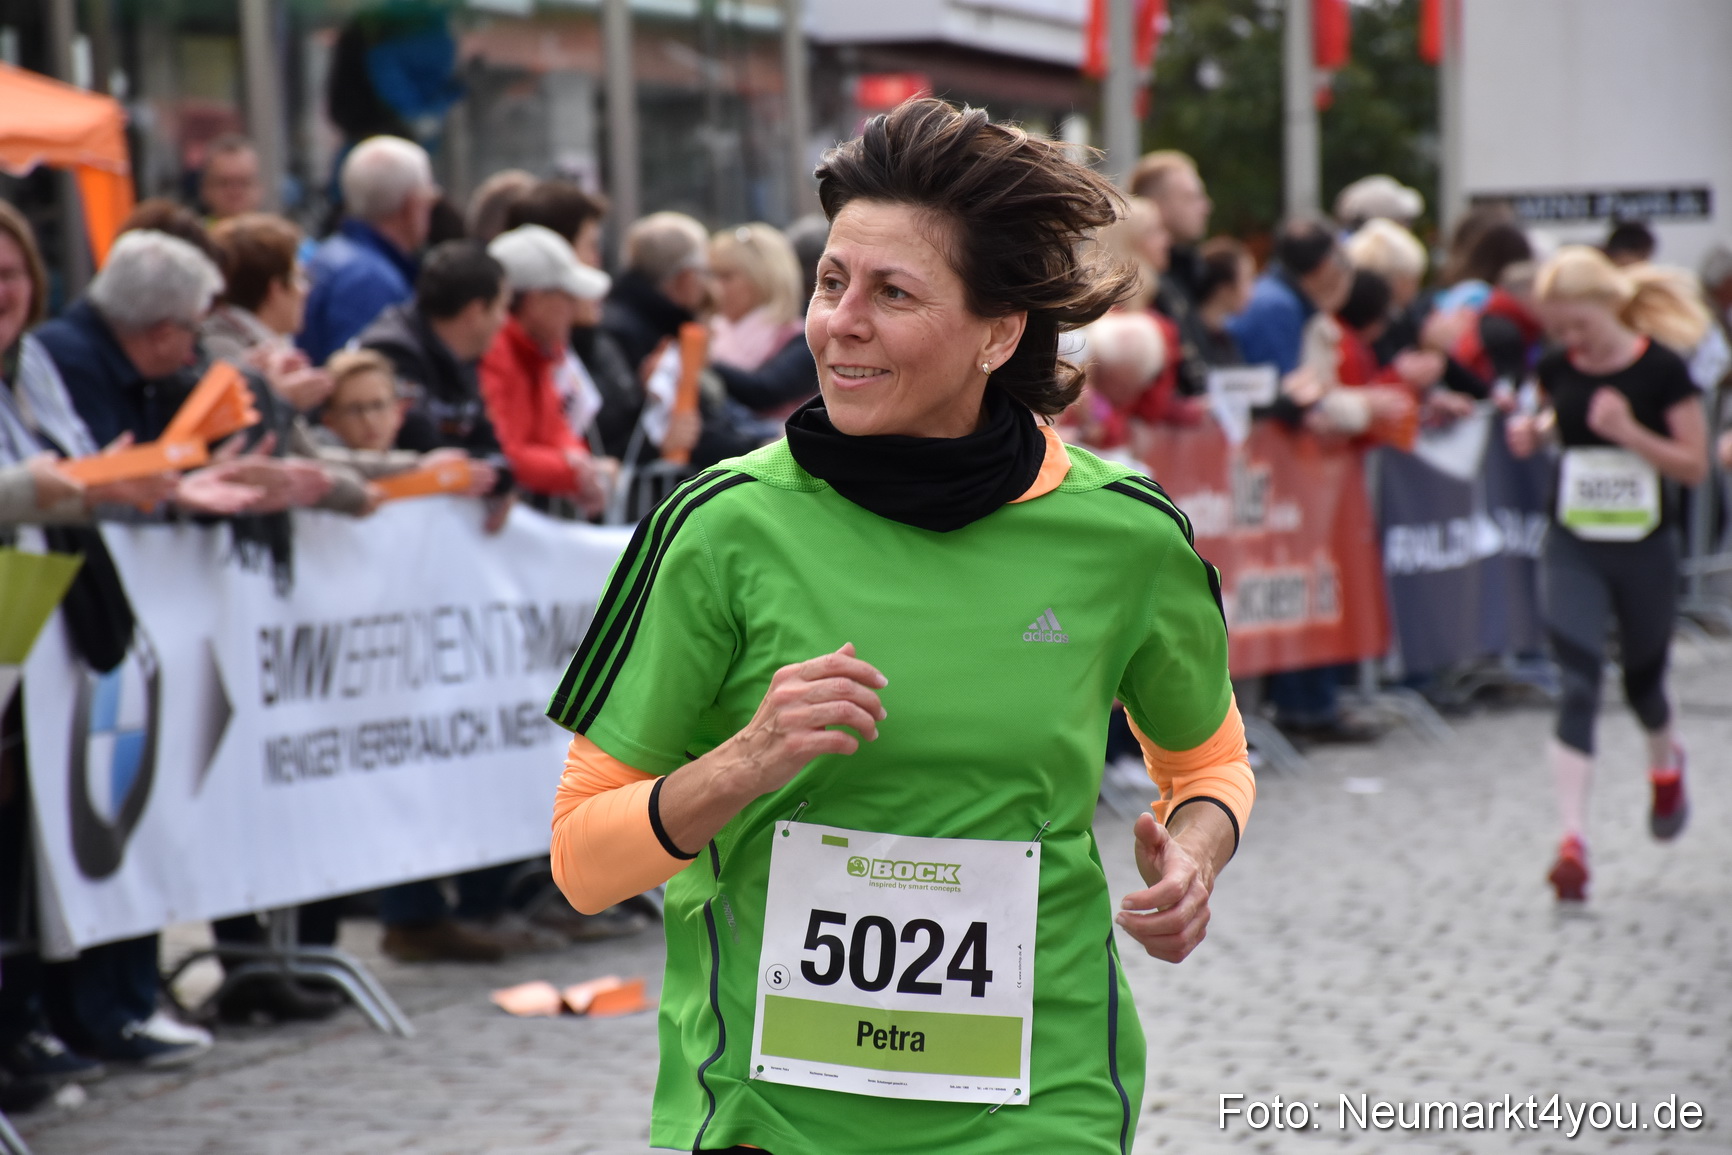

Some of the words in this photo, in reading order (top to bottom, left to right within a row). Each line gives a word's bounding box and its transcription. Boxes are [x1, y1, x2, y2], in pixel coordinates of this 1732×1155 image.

[1022, 629, 1070, 644] adidas
[870, 859, 961, 884] BOCK
[869, 880, 896, 888] inspired
[898, 882, 907, 890] by
[930, 884, 961, 893] concepts
[800, 908, 994, 998] 5024
[773, 970, 782, 984] S
[856, 1020, 926, 1053] Petra
